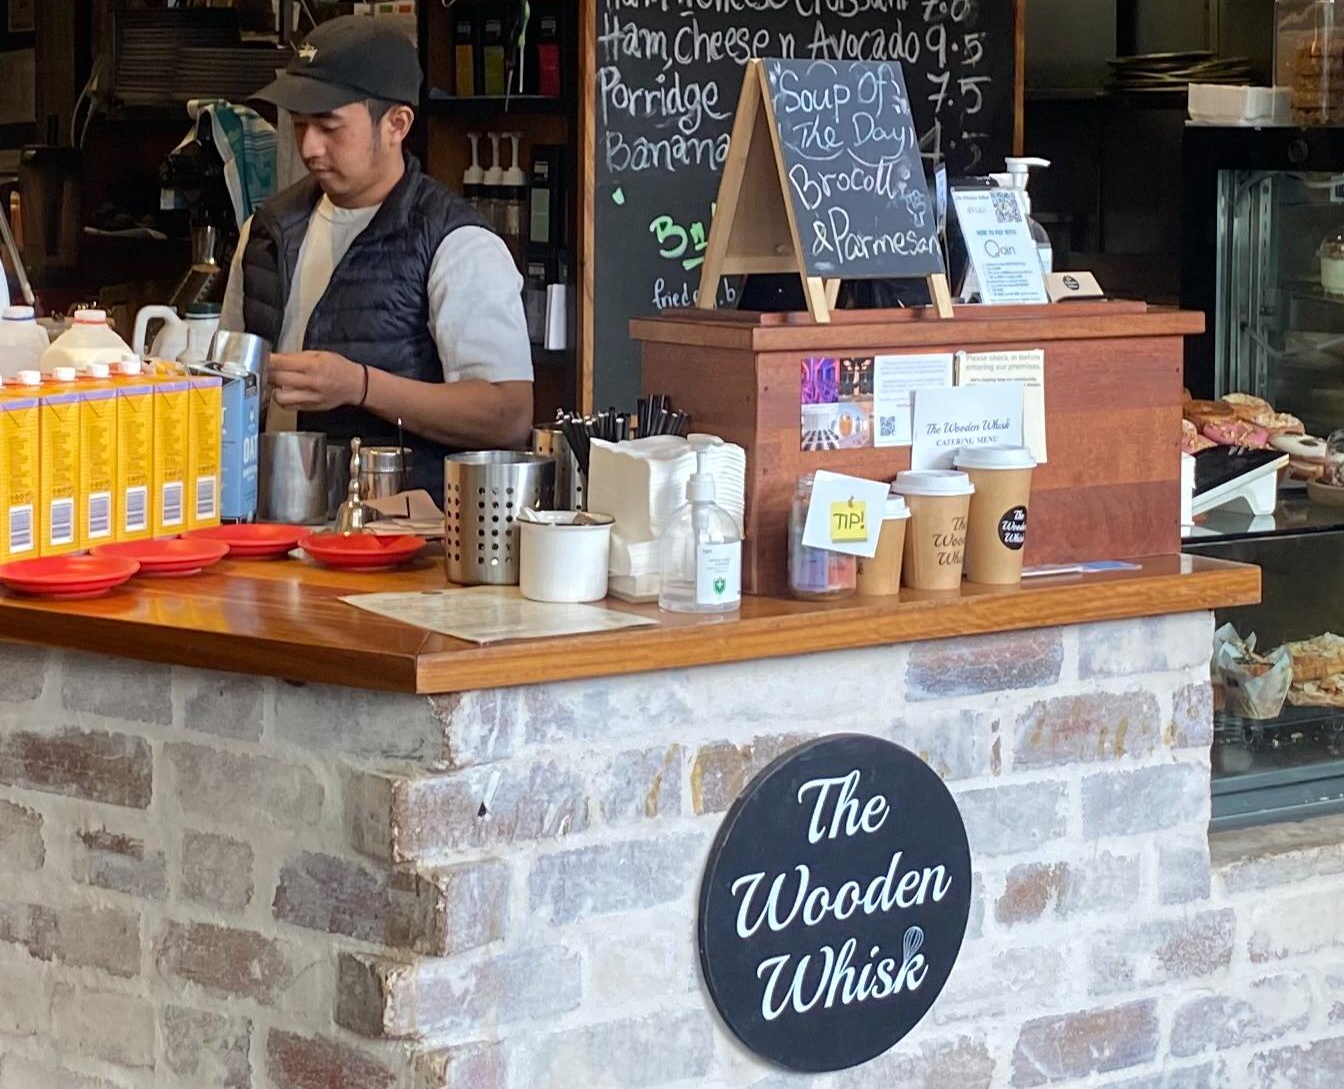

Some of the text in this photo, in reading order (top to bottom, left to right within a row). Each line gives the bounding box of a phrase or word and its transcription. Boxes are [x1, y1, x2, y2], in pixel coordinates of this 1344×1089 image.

[778, 32, 796, 60] n
[807, 18, 921, 63] Avocado
[925, 23, 986, 67] 9.5
[597, 65, 732, 135] Porridge
[779, 64, 892, 123] Soup Of
[927, 70, 992, 114] 7.5
[605, 130, 731, 172] Banana
[792, 112, 905, 160] The Day
[927, 418, 1010, 435] The Wooden Whisk
[936, 435, 998, 447] CATERING MENU
[833, 511, 865, 530] TIP!
[952, 516, 967, 532] Th
[798, 769, 890, 844] The
[731, 851, 953, 939] Wooden
[757, 928, 929, 1021] Whisk
